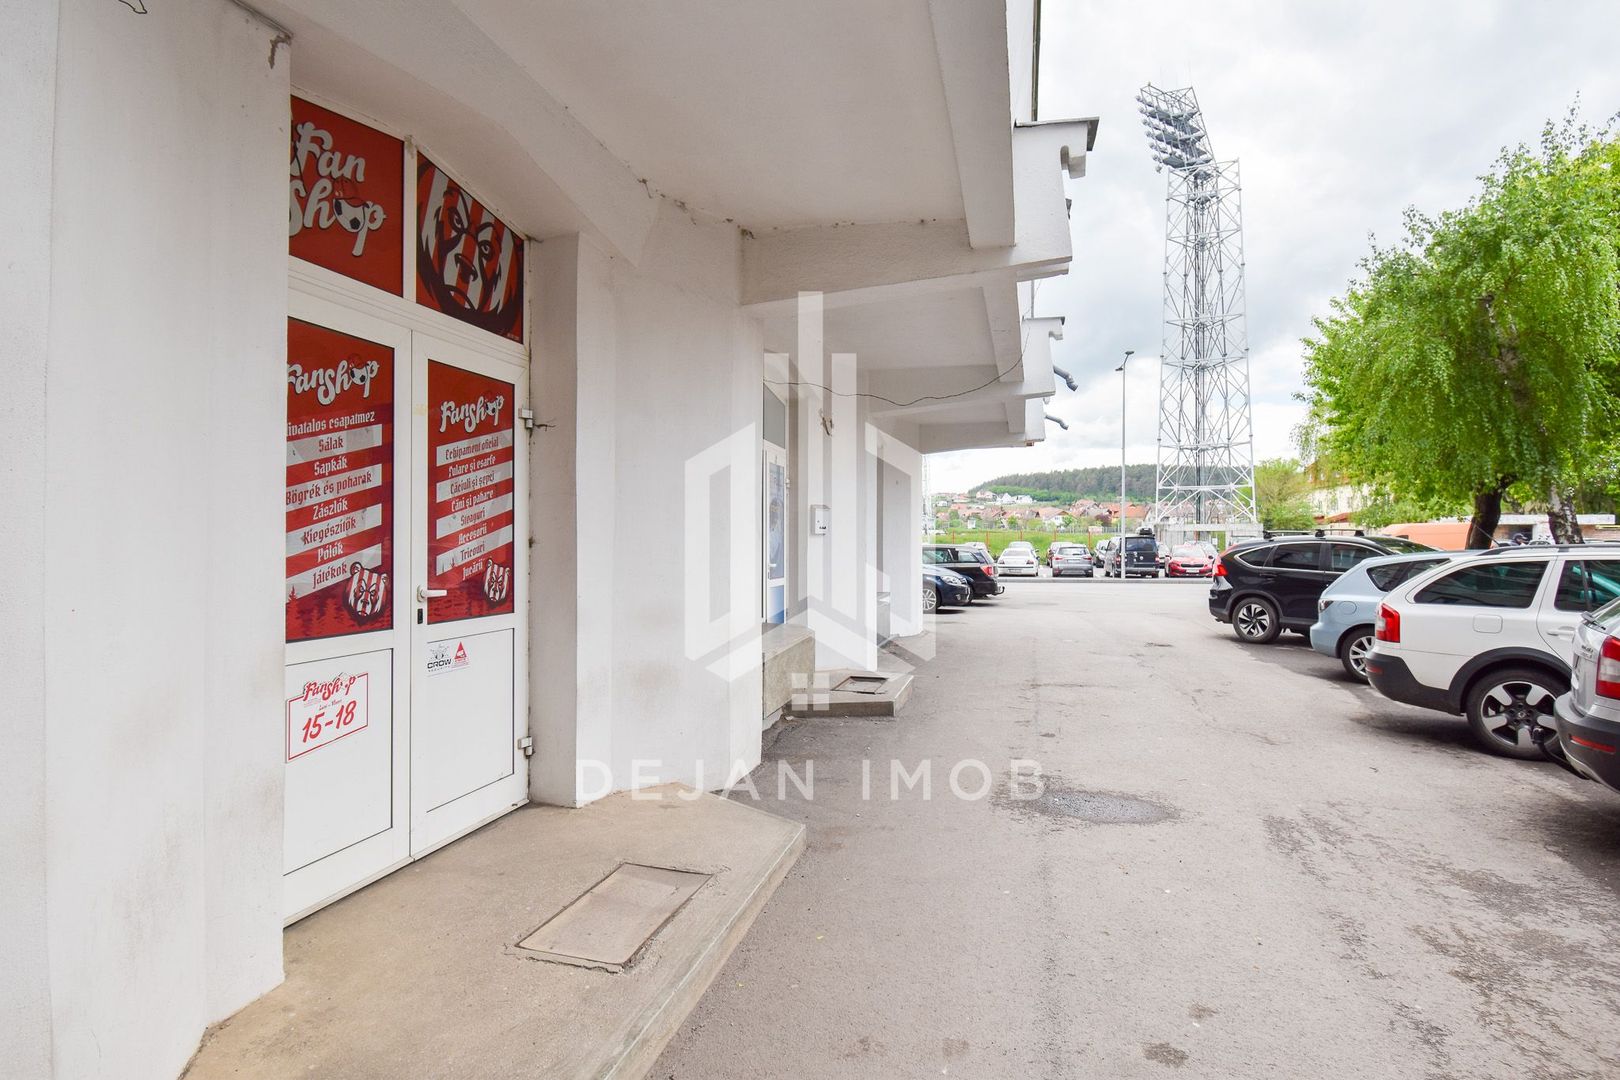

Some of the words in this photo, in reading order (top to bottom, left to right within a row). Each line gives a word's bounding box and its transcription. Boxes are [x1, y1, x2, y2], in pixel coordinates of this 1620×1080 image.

[290, 121, 365, 183] Fan
[287, 418, 326, 436] ivatalos
[318, 436, 344, 452] Sálak
[314, 456, 348, 476] Sapkák
[323, 480, 334, 495] és
[336, 471, 372, 495] poharak
[313, 498, 348, 520] Zászlók
[312, 562, 348, 590] Játékok
[427, 658, 452, 669] CROW
[302, 699, 357, 743] 15-18
